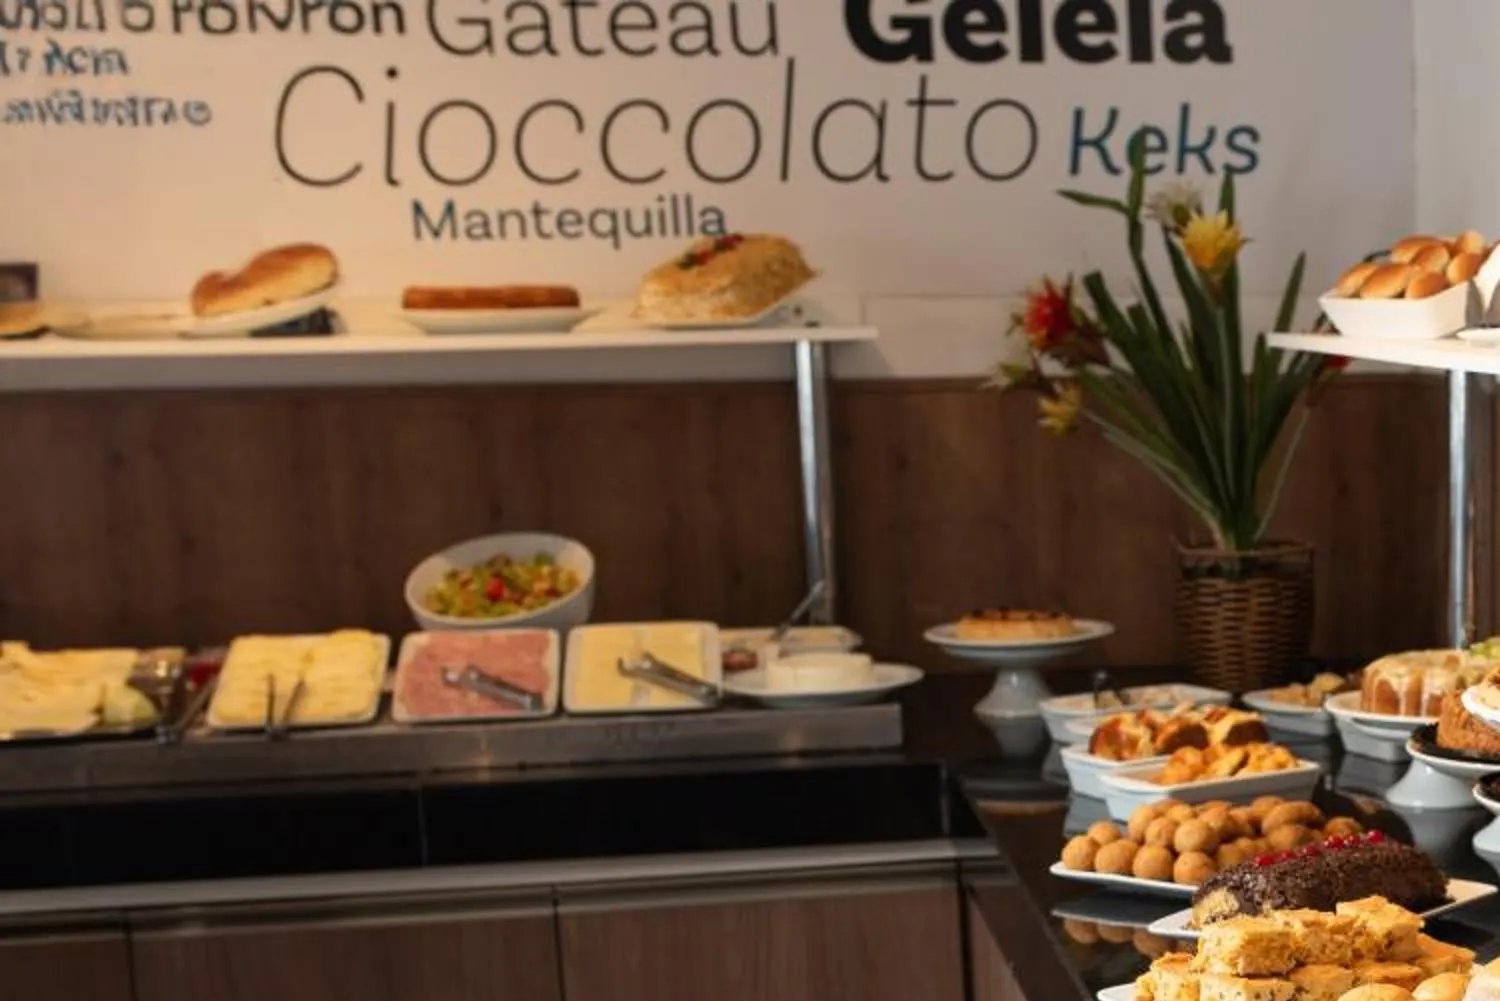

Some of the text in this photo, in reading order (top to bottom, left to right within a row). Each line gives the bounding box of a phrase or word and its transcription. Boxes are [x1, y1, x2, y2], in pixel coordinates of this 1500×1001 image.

[274, 56, 1039, 188] Cioccolato
[1068, 102, 1262, 178] Keks
[411, 193, 729, 251] Mantequilla
